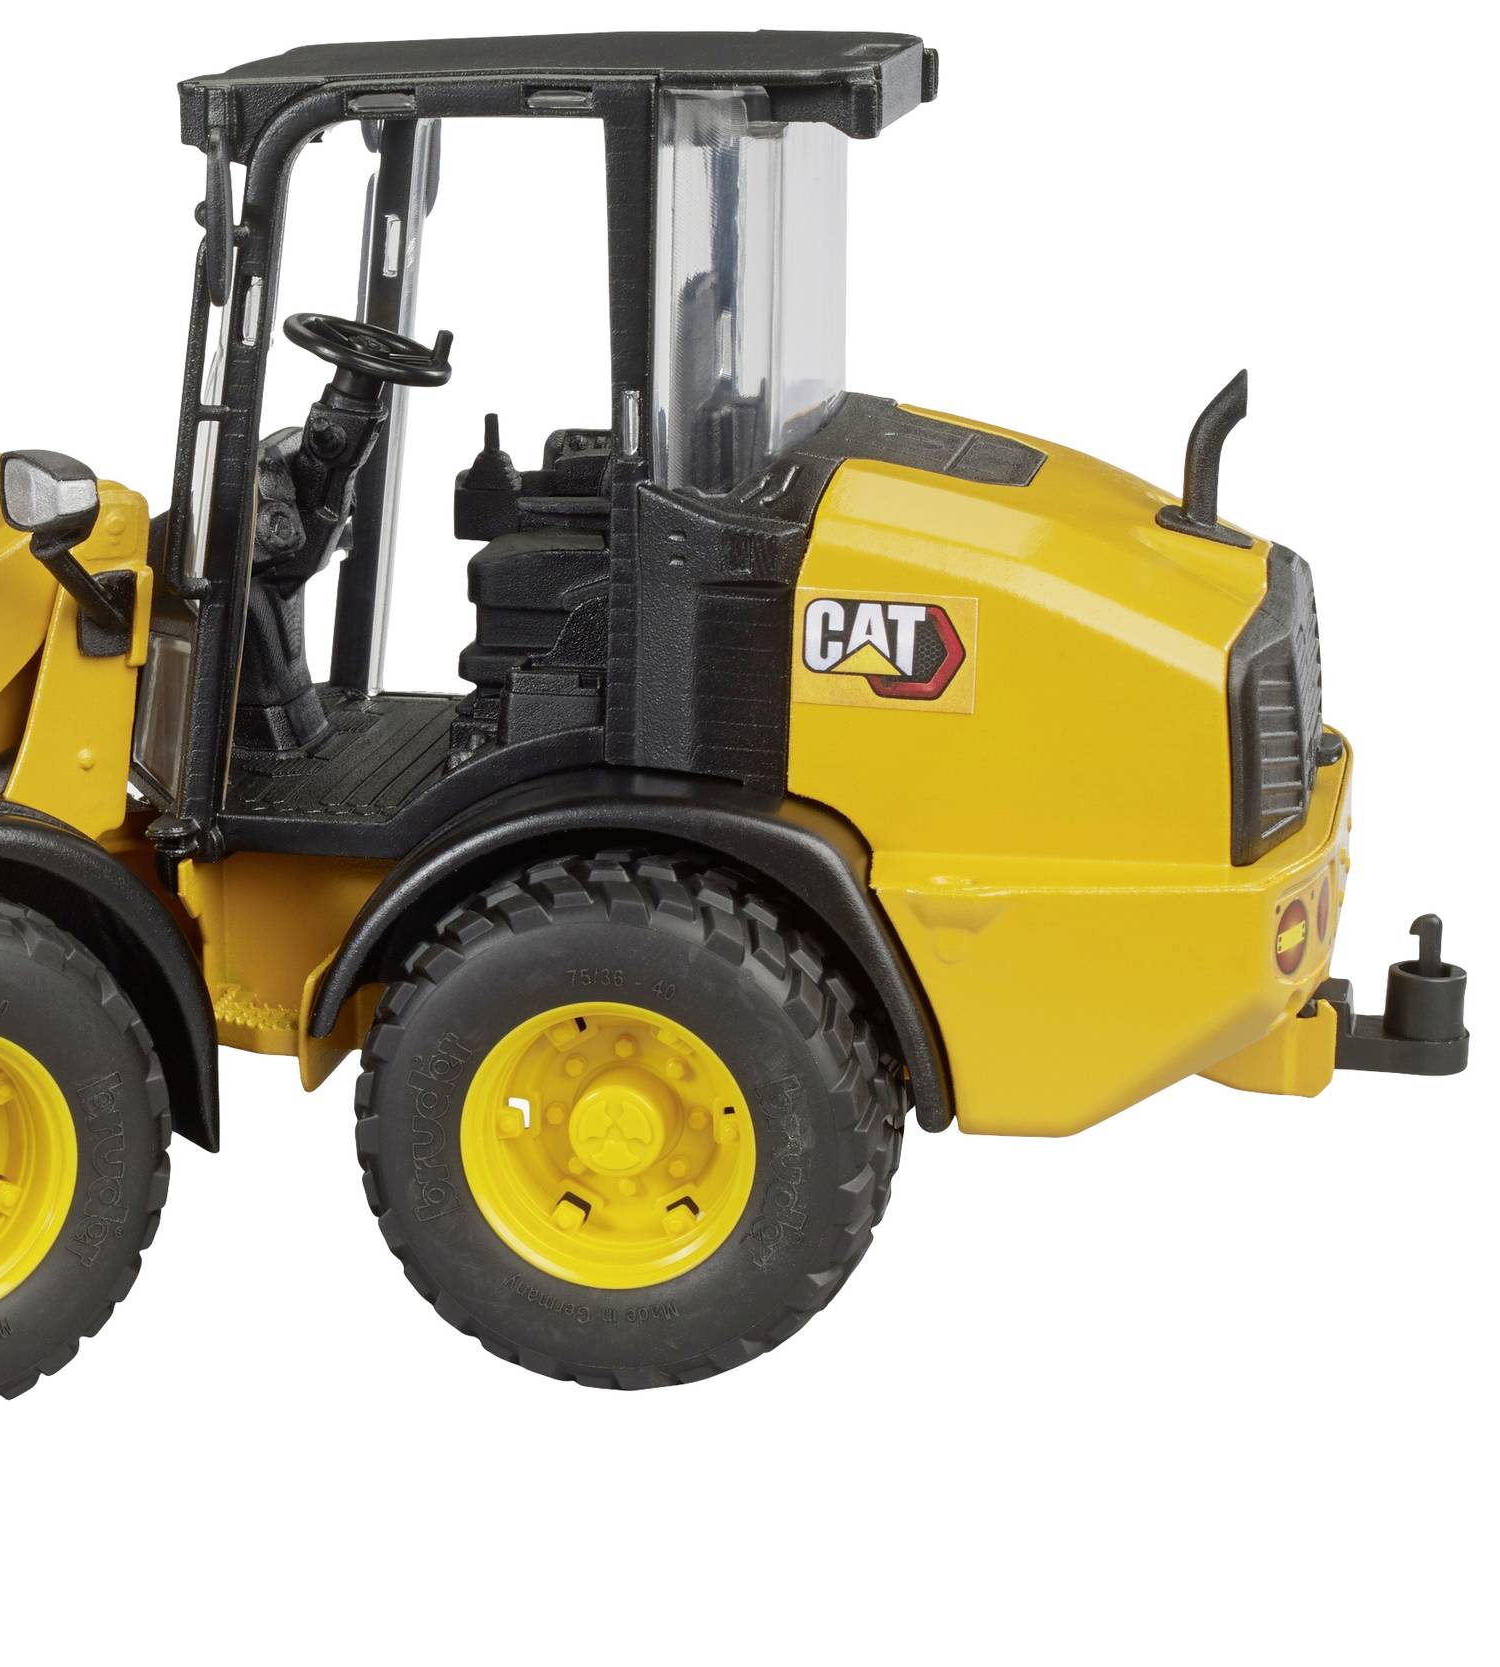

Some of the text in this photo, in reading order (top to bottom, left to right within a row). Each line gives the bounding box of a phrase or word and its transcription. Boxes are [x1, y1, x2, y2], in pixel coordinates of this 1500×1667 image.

[804, 599, 926, 676] CAT
[651, 979, 676, 1000] 40
[500, 1273, 680, 1328] Made in Germany
